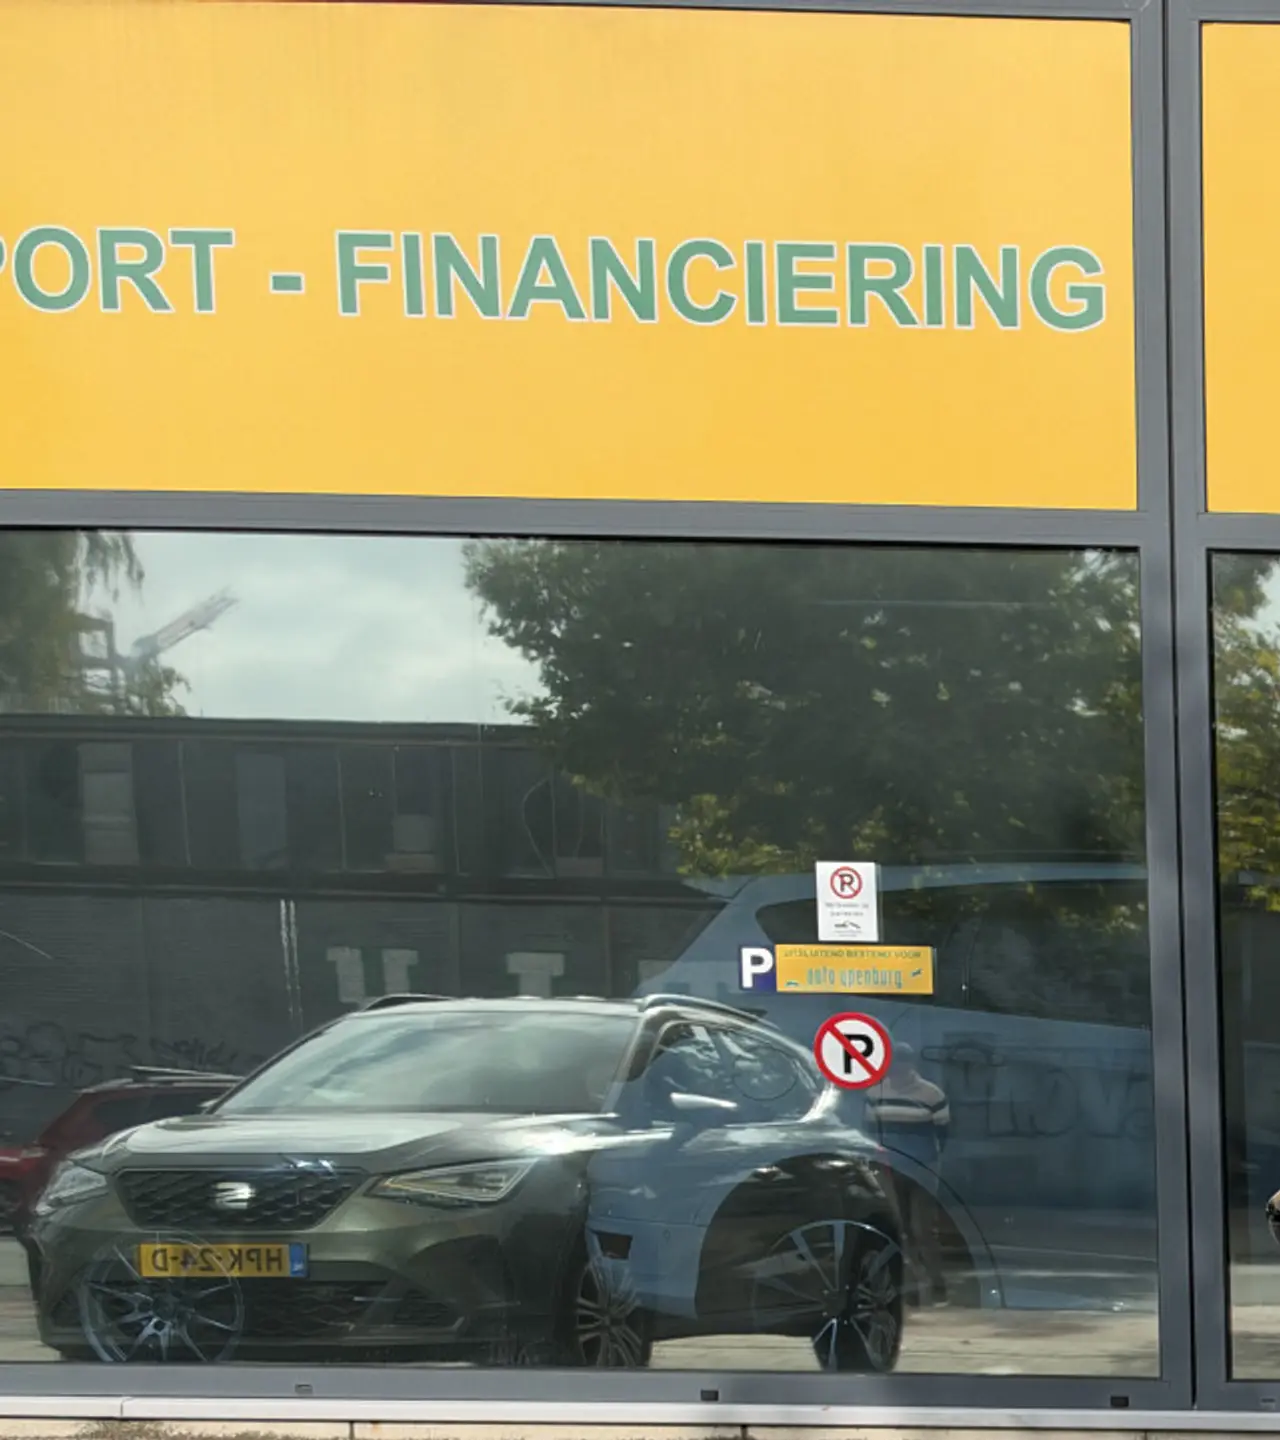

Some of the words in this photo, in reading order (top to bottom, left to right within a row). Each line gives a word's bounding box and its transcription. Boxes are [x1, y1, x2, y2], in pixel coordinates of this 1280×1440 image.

[0, 225, 236, 313] ORT
[335, 231, 1106, 332] FINANCIERING
[741, 947, 773, 988] P
